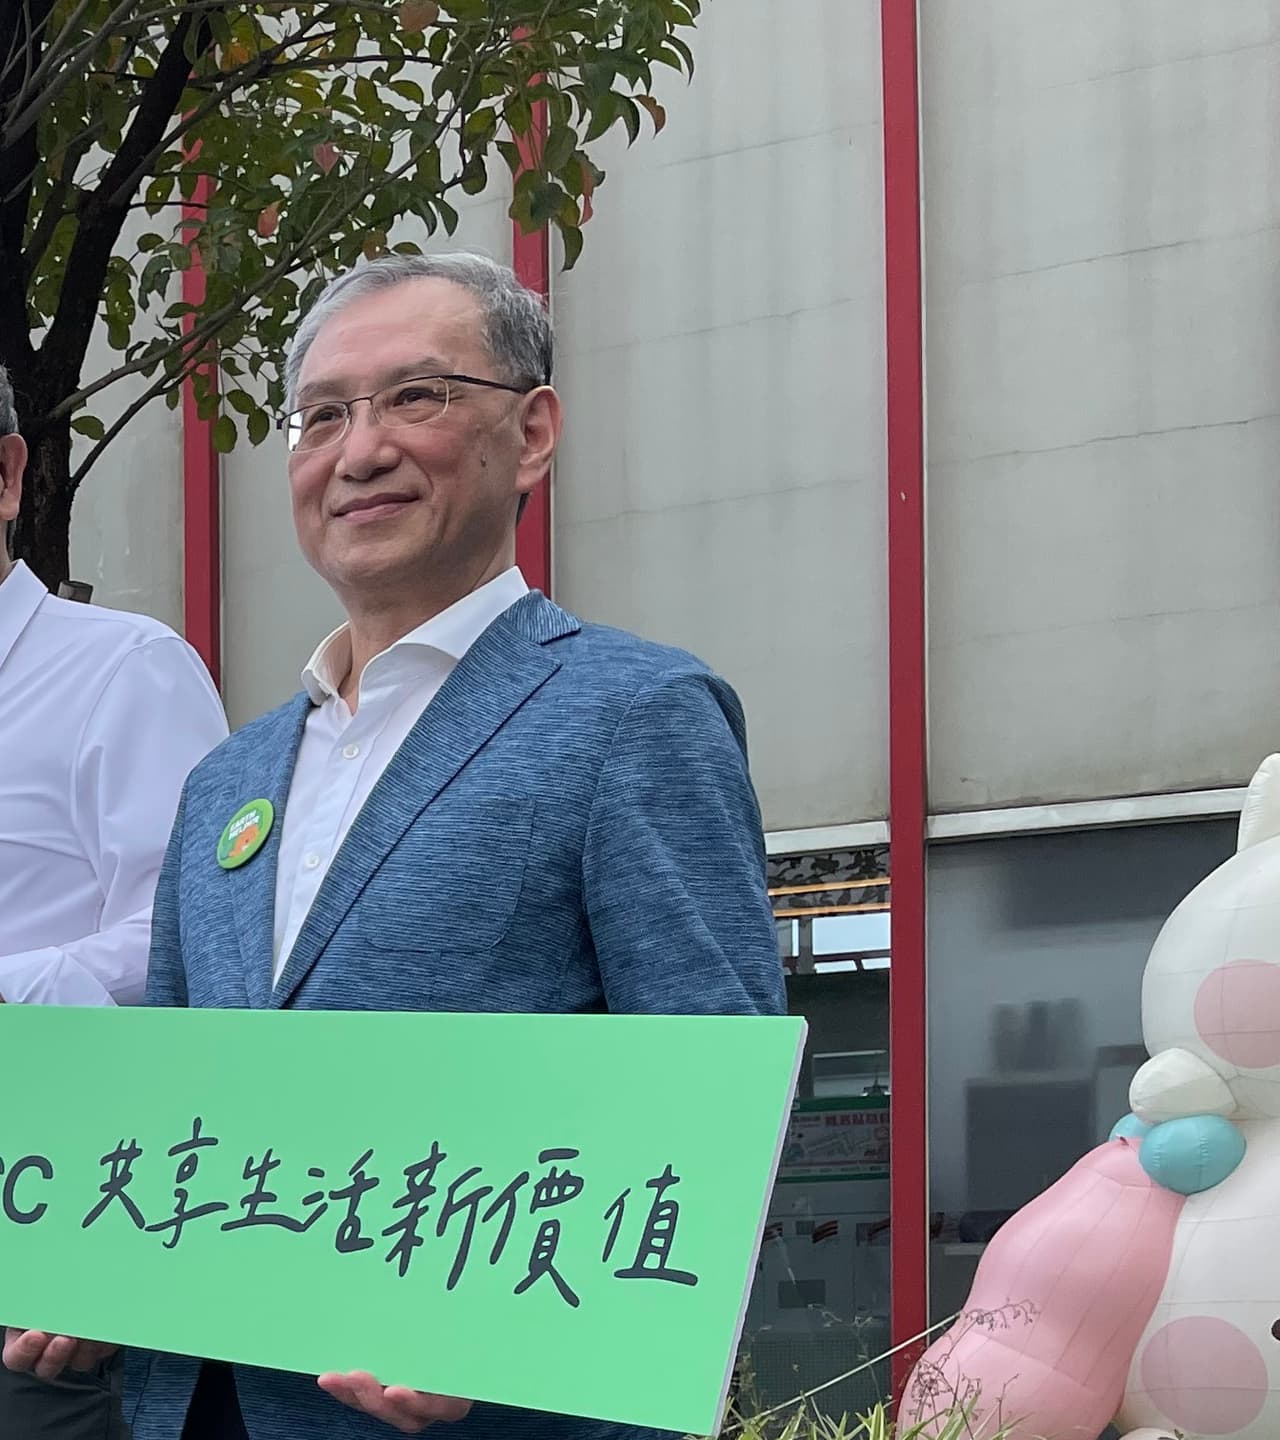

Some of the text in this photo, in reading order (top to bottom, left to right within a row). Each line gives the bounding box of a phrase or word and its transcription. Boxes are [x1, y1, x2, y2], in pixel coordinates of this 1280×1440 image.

[82, 1116, 699, 1308] 共享生活新價值
